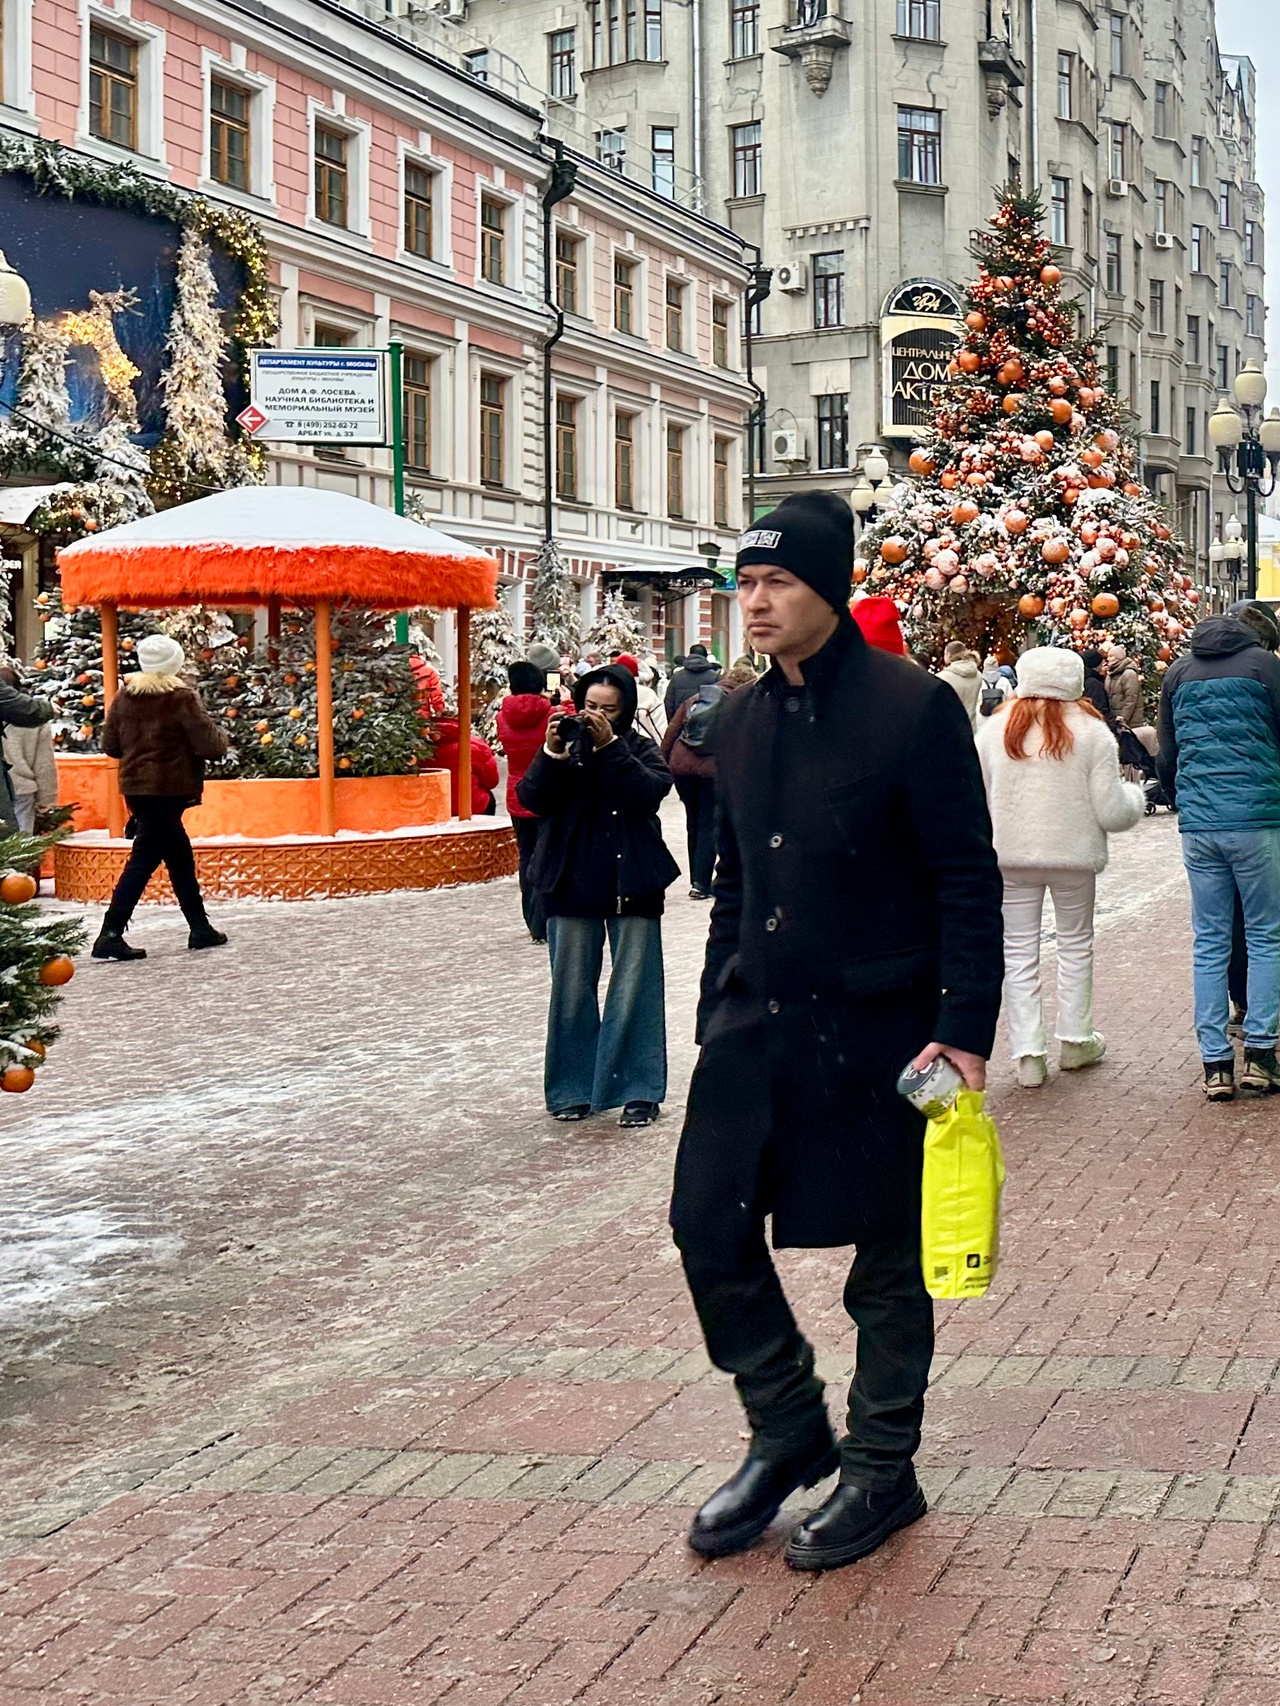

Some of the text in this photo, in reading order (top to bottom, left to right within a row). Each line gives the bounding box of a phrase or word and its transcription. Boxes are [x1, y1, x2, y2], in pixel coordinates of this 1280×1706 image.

[902, 361, 952, 381] ДОМ
[309, 397, 365, 405] БИБЛИОТЕКА
[265, 404, 375, 413] МЕМОРИАЛЬНЫЙ МУЗЕЙ
[303, 421, 322, 429] (499)
